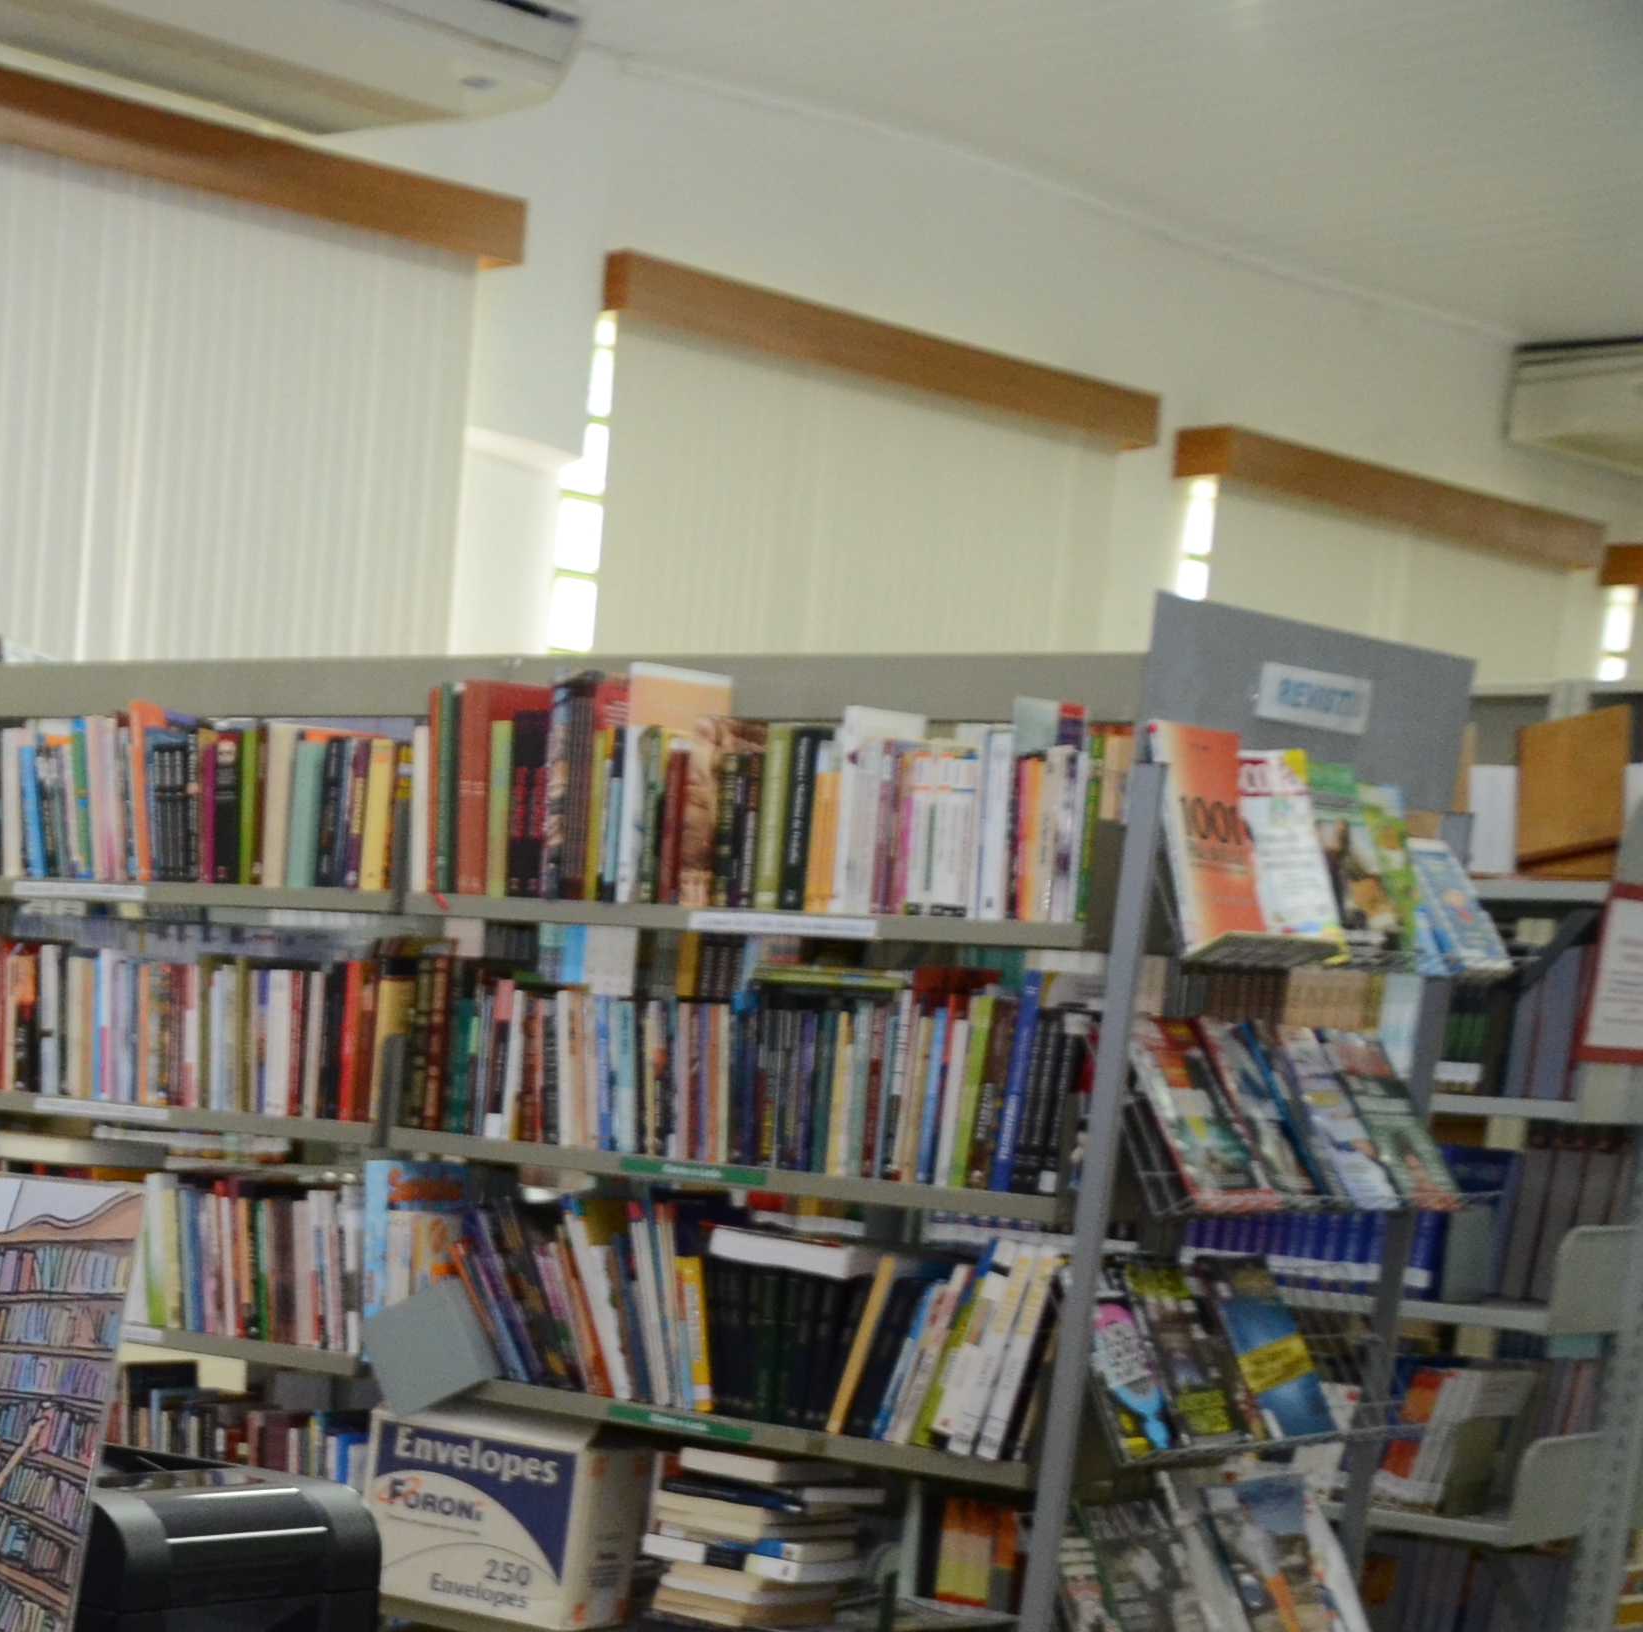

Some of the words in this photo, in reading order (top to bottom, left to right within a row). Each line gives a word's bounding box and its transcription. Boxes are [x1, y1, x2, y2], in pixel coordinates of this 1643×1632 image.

[393, 1426, 560, 1485] Envelopes
[429, 1572, 528, 1611] Envelopes
[485, 1558, 532, 1588] 250
